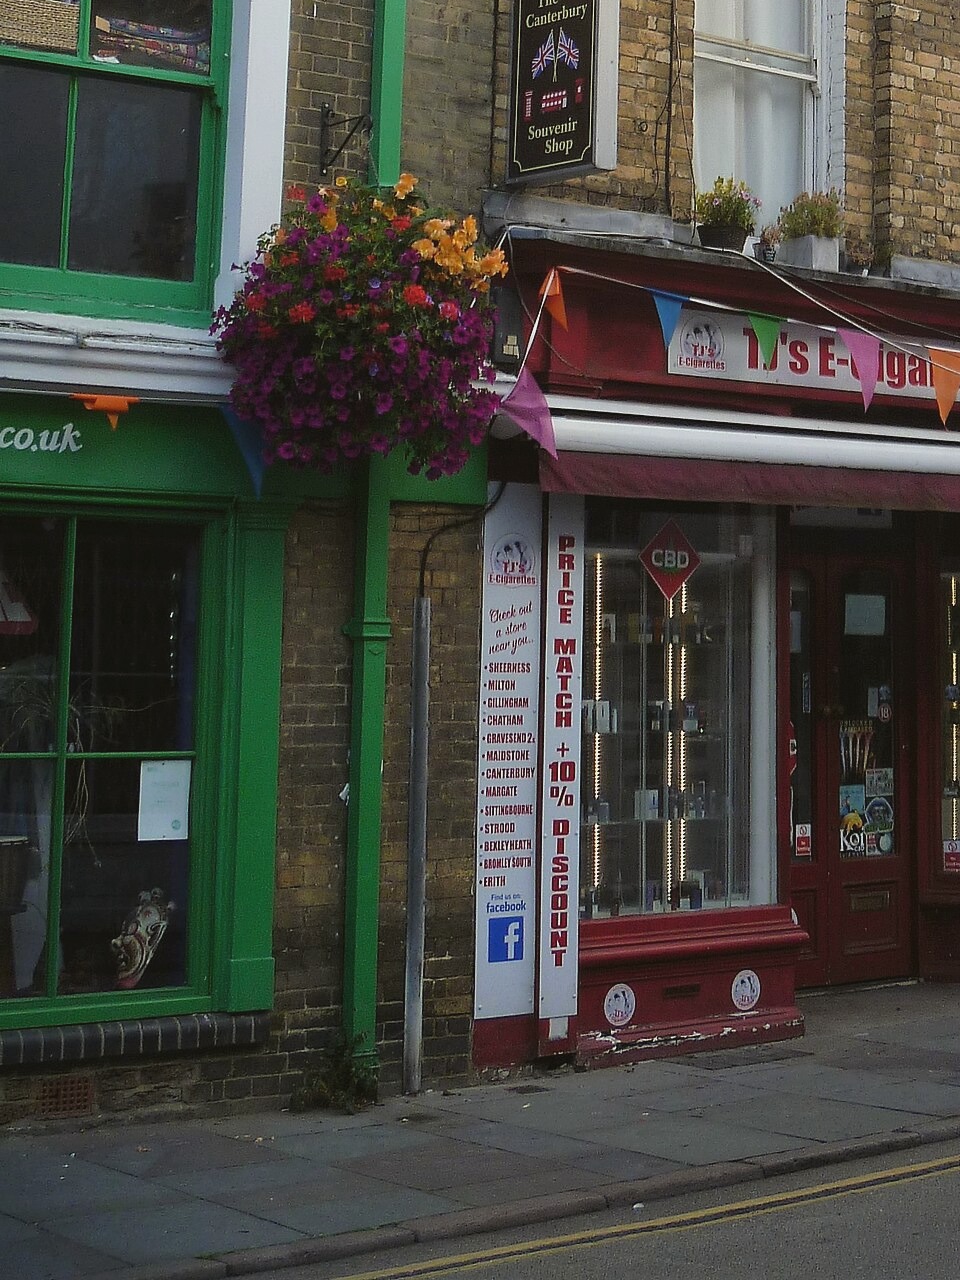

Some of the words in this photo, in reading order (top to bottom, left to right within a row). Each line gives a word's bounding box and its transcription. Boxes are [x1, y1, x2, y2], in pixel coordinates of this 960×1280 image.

[525, 2, 588, 29] Canterbury
[528, 117, 578, 140] Souvenir
[544, 138, 573, 155] Shop
[692, 343, 714, 357] TJ's
[678, 357, 725, 371] E-Cigarettes
[0, 423, 83, 453] co.uk
[652, 549, 689, 569] CBD
[503, 560, 525, 574] TJ's
[489, 574, 536, 585] E-Cigarettes
[558, 535, 575, 624] PRICE
[489, 604, 516, 623] Check
[519, 601, 533, 615] out
[495, 629, 502, 638] a
[505, 622, 527, 636] store
[488, 640, 510, 655] near
[488, 662, 531, 673] SHEERNESS
[487, 680, 516, 690] MILTON
[554, 638, 577, 728] MATCH
[487, 697, 529, 708] GILLINGHAM
[880, 707, 890, 719] 18
[487, 715, 524, 726] CHATHAM
[486, 733, 526, 744] GRAVESEND
[486, 750, 530, 761] MAIDSTONE
[485, 768, 536, 779] CANTERBURY
[485, 785, 518, 797] MARGATE
[484, 804, 534, 817] SITTINGBOURNE
[484, 822, 516, 834] STROOD
[483, 858, 511, 870] BROMLEY
[512, 856, 532, 868] SOUTH
[483, 875, 506, 888] ERITH
[491, 893, 504, 901] Find
[551, 819, 570, 967] DISCOUNT
[486, 900, 526, 913] facebook
